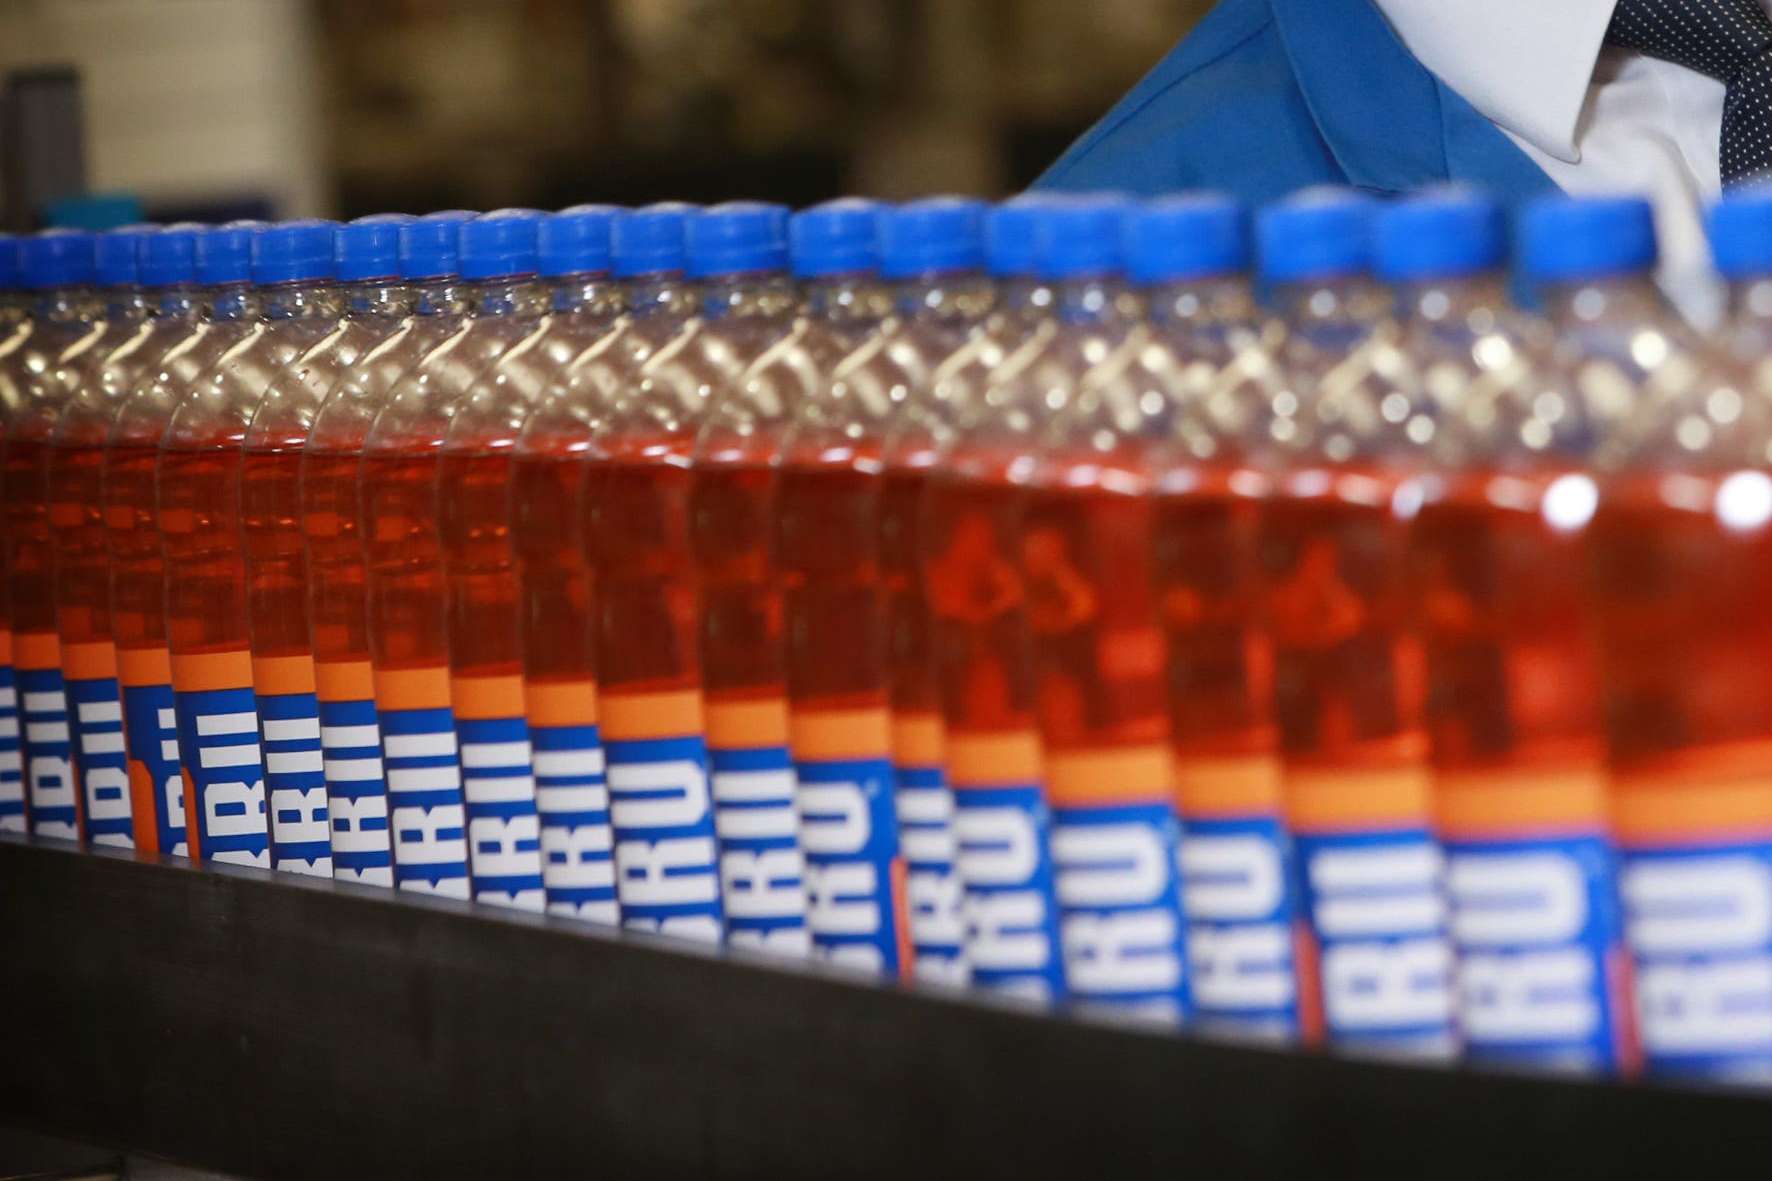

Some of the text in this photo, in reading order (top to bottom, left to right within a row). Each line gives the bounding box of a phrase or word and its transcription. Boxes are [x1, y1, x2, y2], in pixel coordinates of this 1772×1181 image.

[196, 712, 271, 869] RU
[263, 717, 333, 878] RU
[321, 724, 394, 888] RU
[384, 731, 470, 899] RU
[462, 741, 547, 914] RU
[533, 748, 621, 925] RU
[606, 759, 722, 947] RU
[712, 768, 812, 957] RU
[799, 781, 884, 979] RU
[955, 805, 1050, 1001] RU
[1050, 822, 1181, 1031] RU
[1178, 833, 1295, 1041] RU
[1308, 843, 1455, 1059] RU
[1450, 850, 1597, 1071] RU
